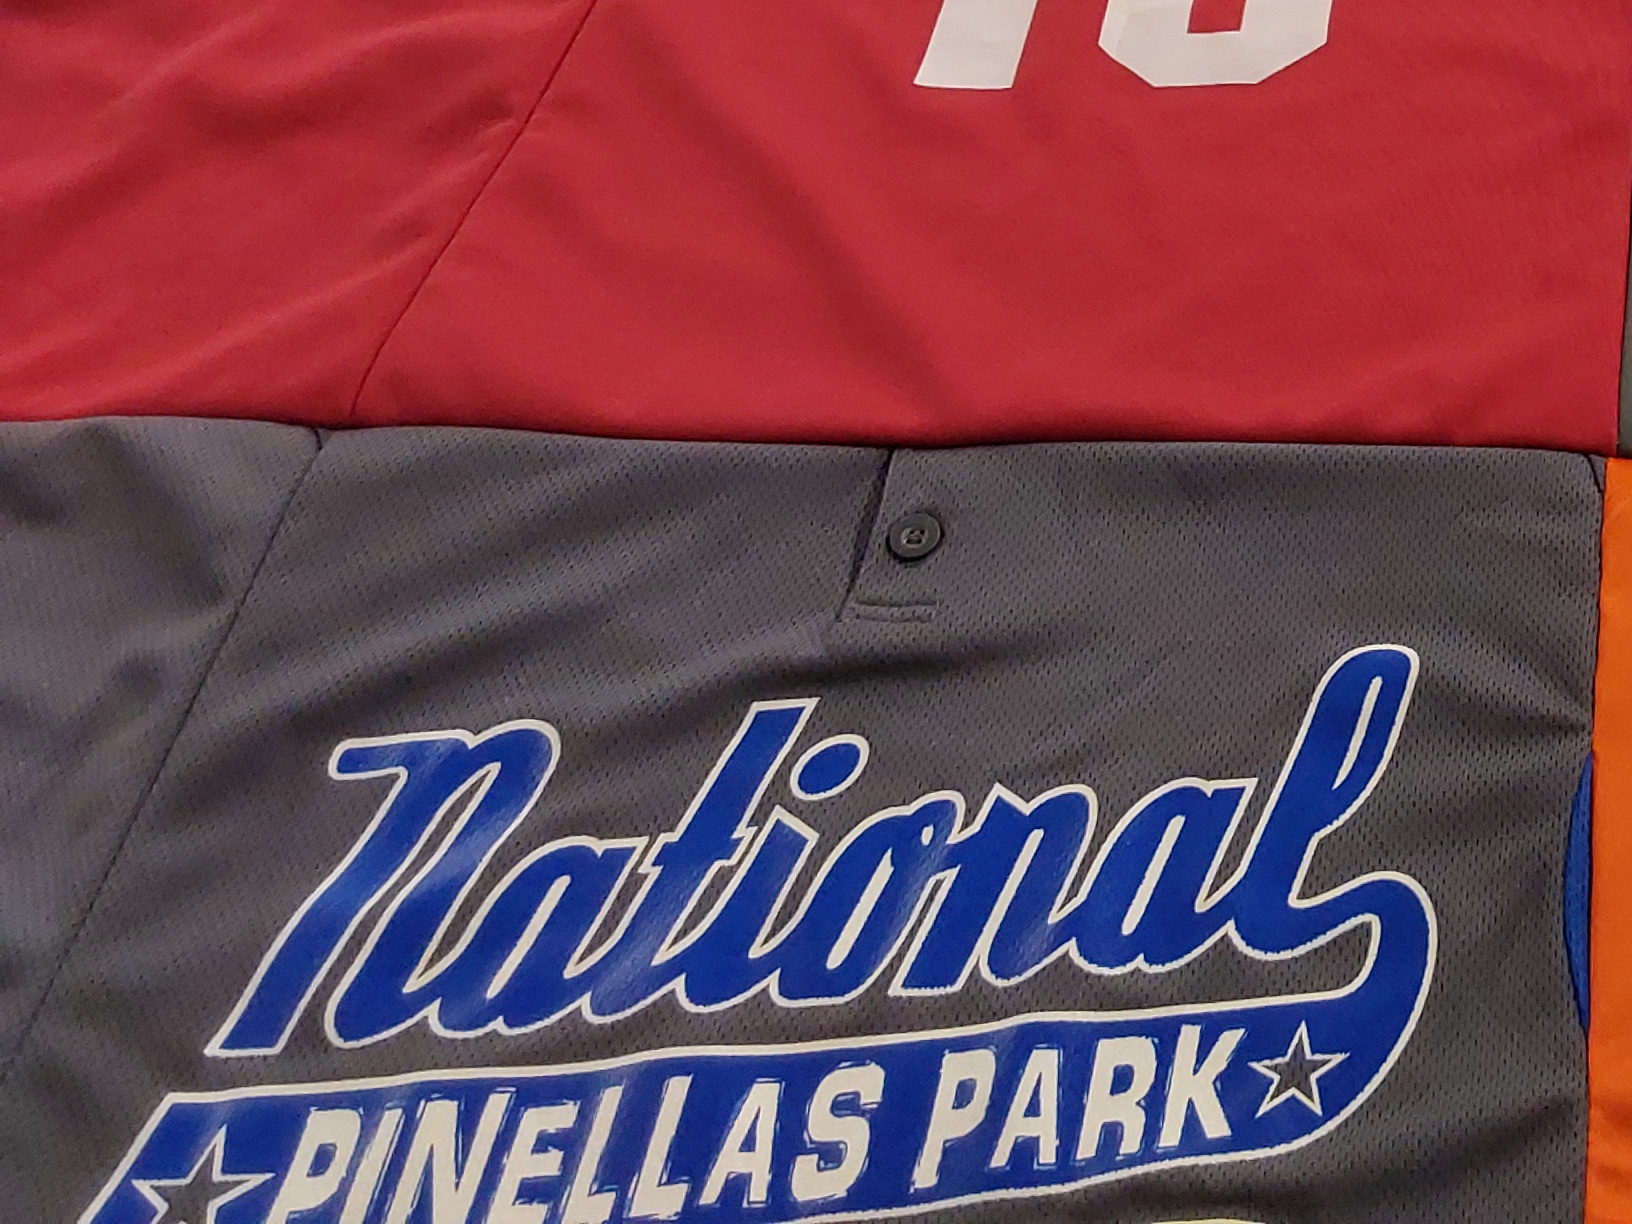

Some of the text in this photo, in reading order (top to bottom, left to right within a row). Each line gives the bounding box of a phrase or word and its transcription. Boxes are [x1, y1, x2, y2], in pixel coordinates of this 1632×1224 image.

[206, 642, 1414, 1058] National
[268, 1024, 1248, 1224] PINELLAS PARK
